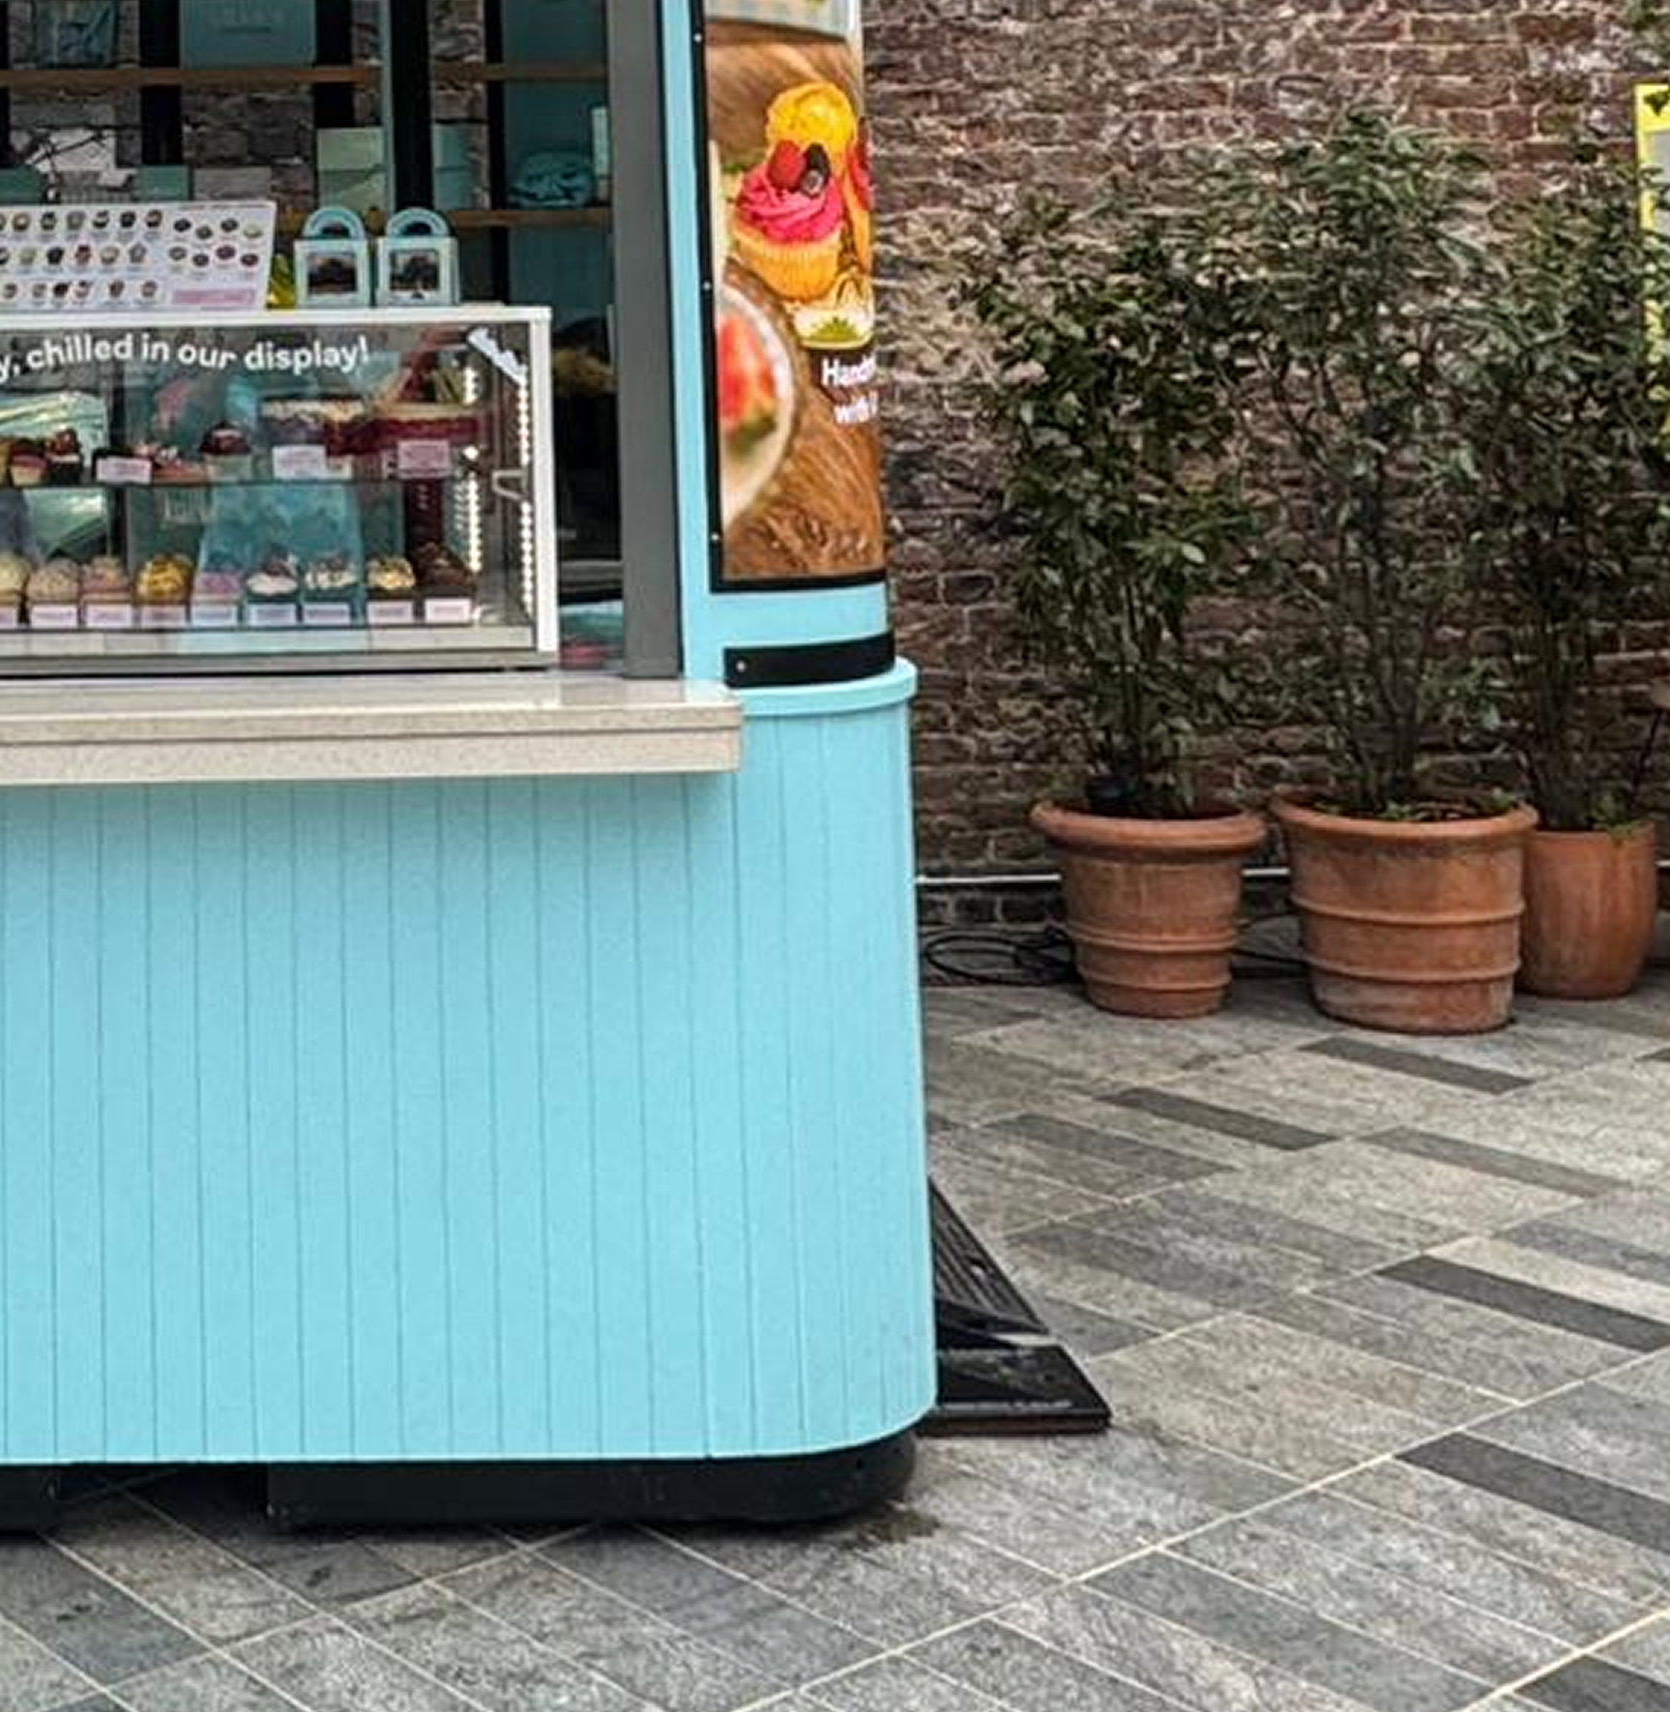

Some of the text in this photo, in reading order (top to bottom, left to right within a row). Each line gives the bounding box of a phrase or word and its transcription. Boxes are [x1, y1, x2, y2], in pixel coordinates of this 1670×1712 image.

[26, 333, 134, 372] chilled
[141, 332, 171, 363] in
[178, 343, 237, 370] our
[244, 334, 371, 376] display!
